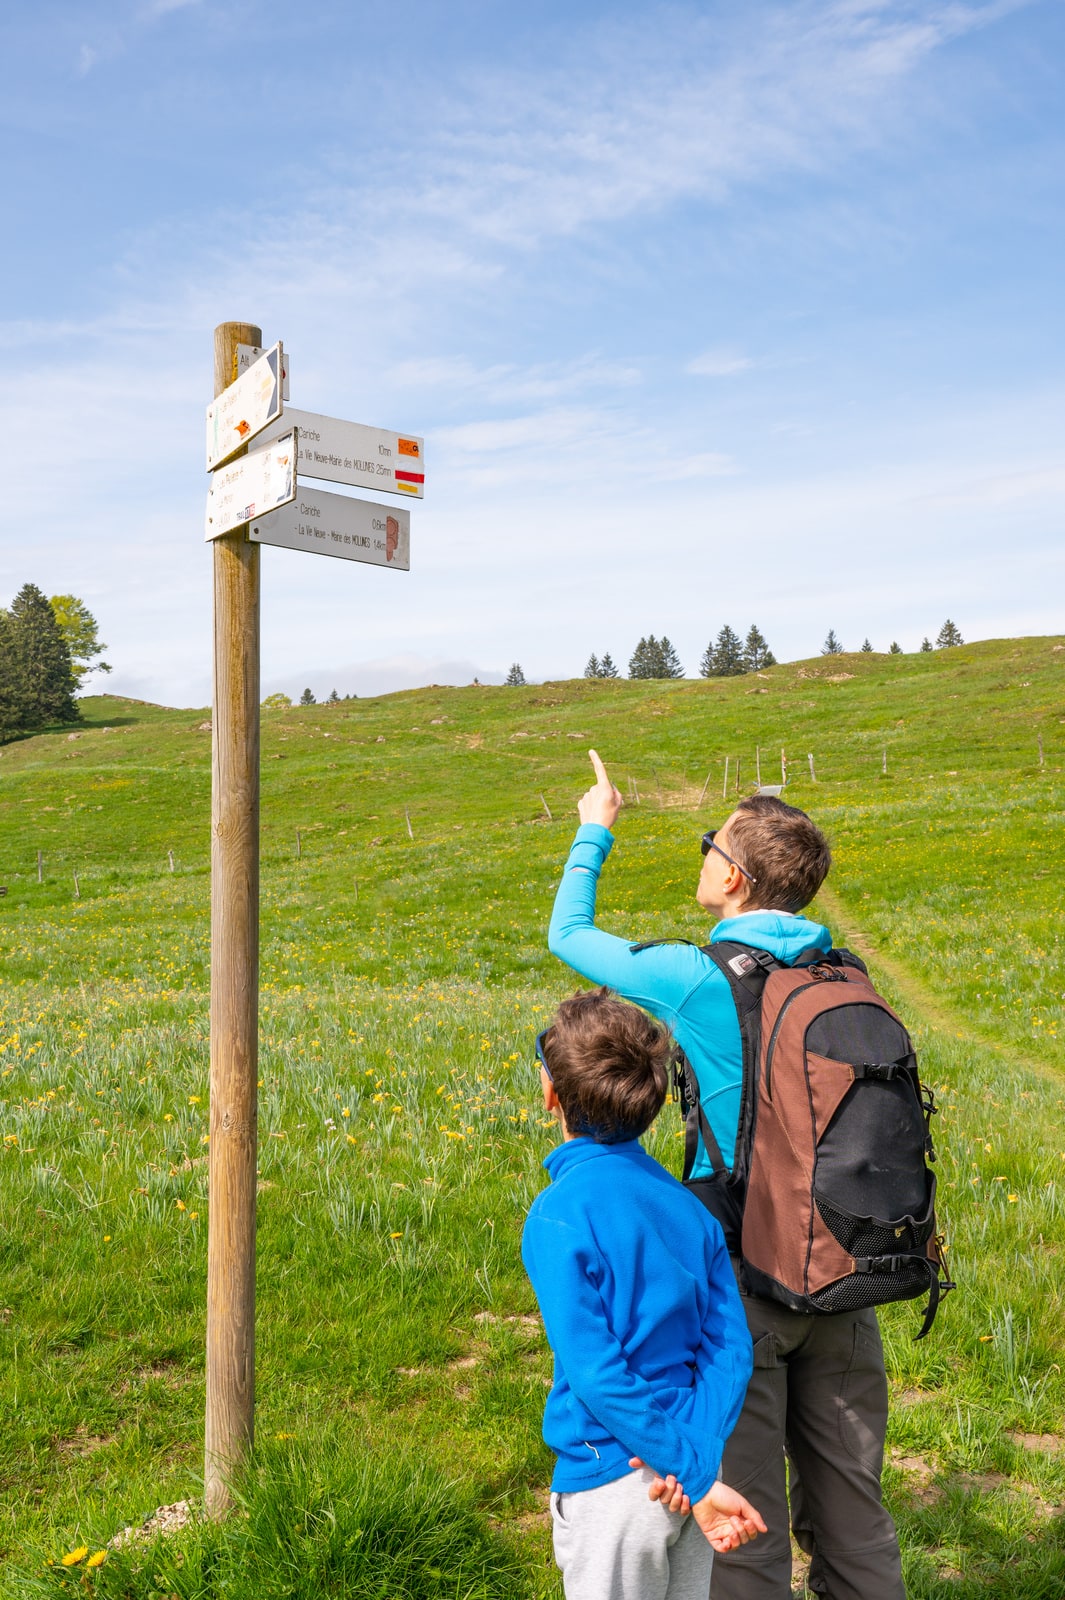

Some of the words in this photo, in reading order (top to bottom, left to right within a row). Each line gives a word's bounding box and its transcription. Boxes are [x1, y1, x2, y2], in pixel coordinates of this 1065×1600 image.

[299, 427, 320, 442] Cariche
[344, 459, 352, 469] des
[300, 503, 320, 517] Cariche
[298, 523, 305, 535] La
